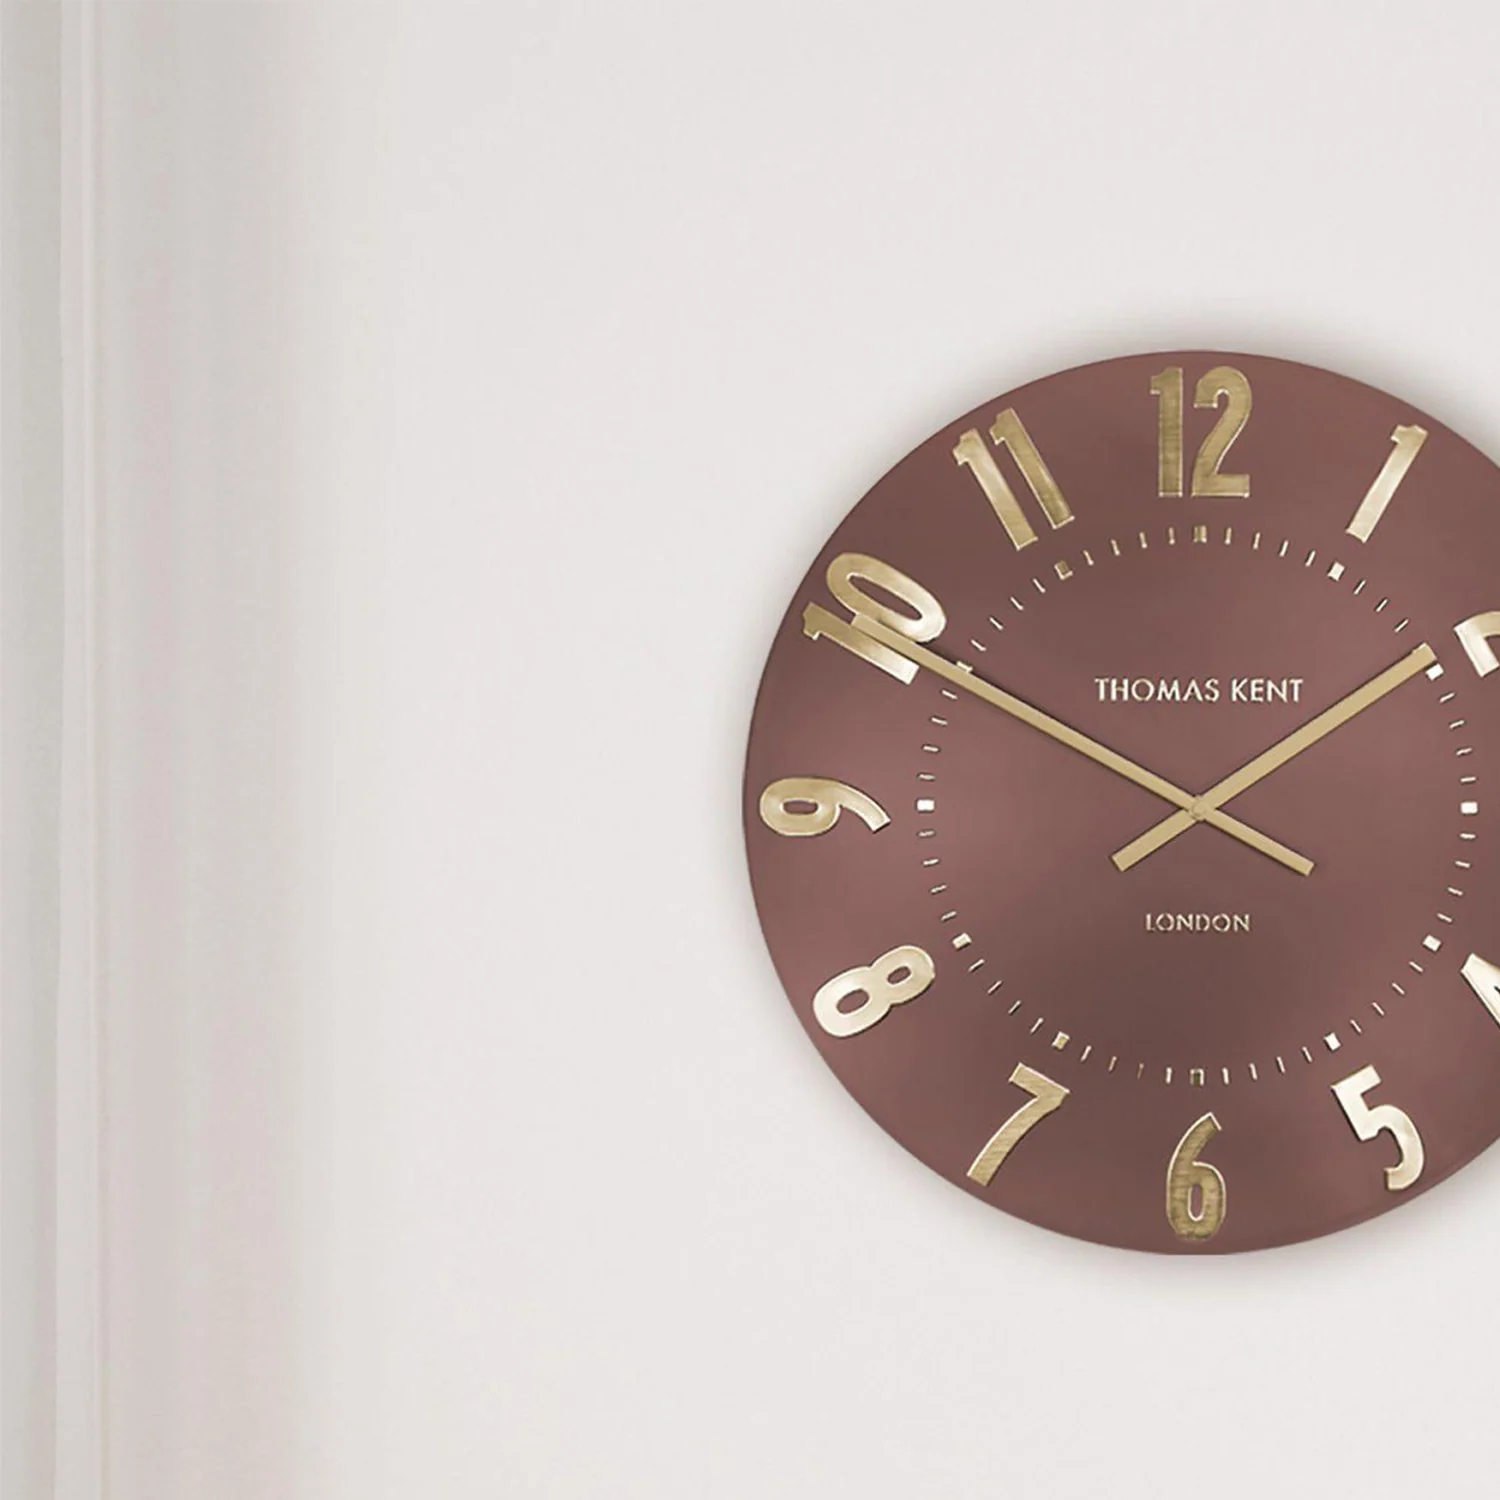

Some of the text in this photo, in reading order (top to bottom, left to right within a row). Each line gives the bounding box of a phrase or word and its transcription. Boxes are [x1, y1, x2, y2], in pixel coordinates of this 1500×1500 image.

[952, 408, 1074, 550] 11
[1150, 366, 1253, 498] 12
[1347, 423, 1428, 542] 1
[802, 552, 946, 685] 10
[1095, 677, 1303, 703] THOMAS KENT
[760, 776, 891, 836] 9
[1145, 913, 1250, 933] LONDON
[813, 945, 936, 1038] 8
[967, 1062, 1070, 1187] 7
[1166, 1112, 1226, 1240] 6
[1331, 1065, 1425, 1190] 5
